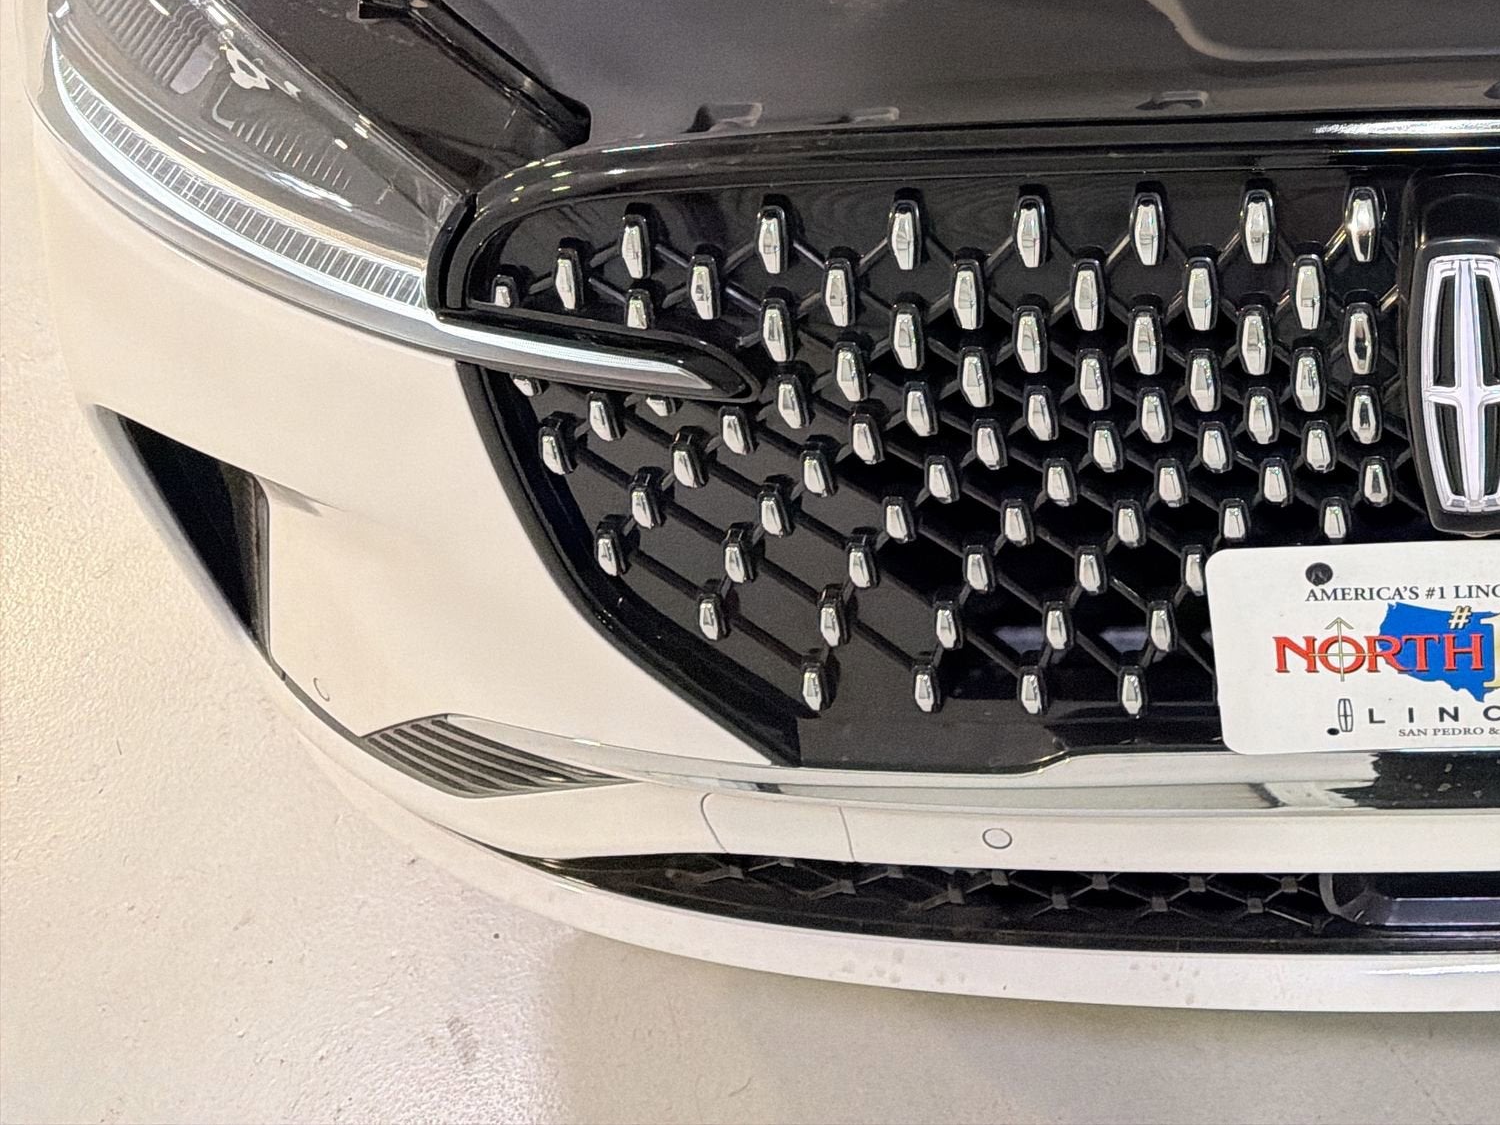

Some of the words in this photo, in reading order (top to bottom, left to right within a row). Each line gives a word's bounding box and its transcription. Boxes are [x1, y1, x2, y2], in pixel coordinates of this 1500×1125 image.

[1305, 585, 1419, 602] AMERICA'S
[1425, 585, 1446, 600] #1
[1272, 630, 1486, 673] NORTH
[1398, 728, 1428, 737] SAN
[1432, 726, 1484, 736] PEDRO
[1488, 726, 1500, 735] &
